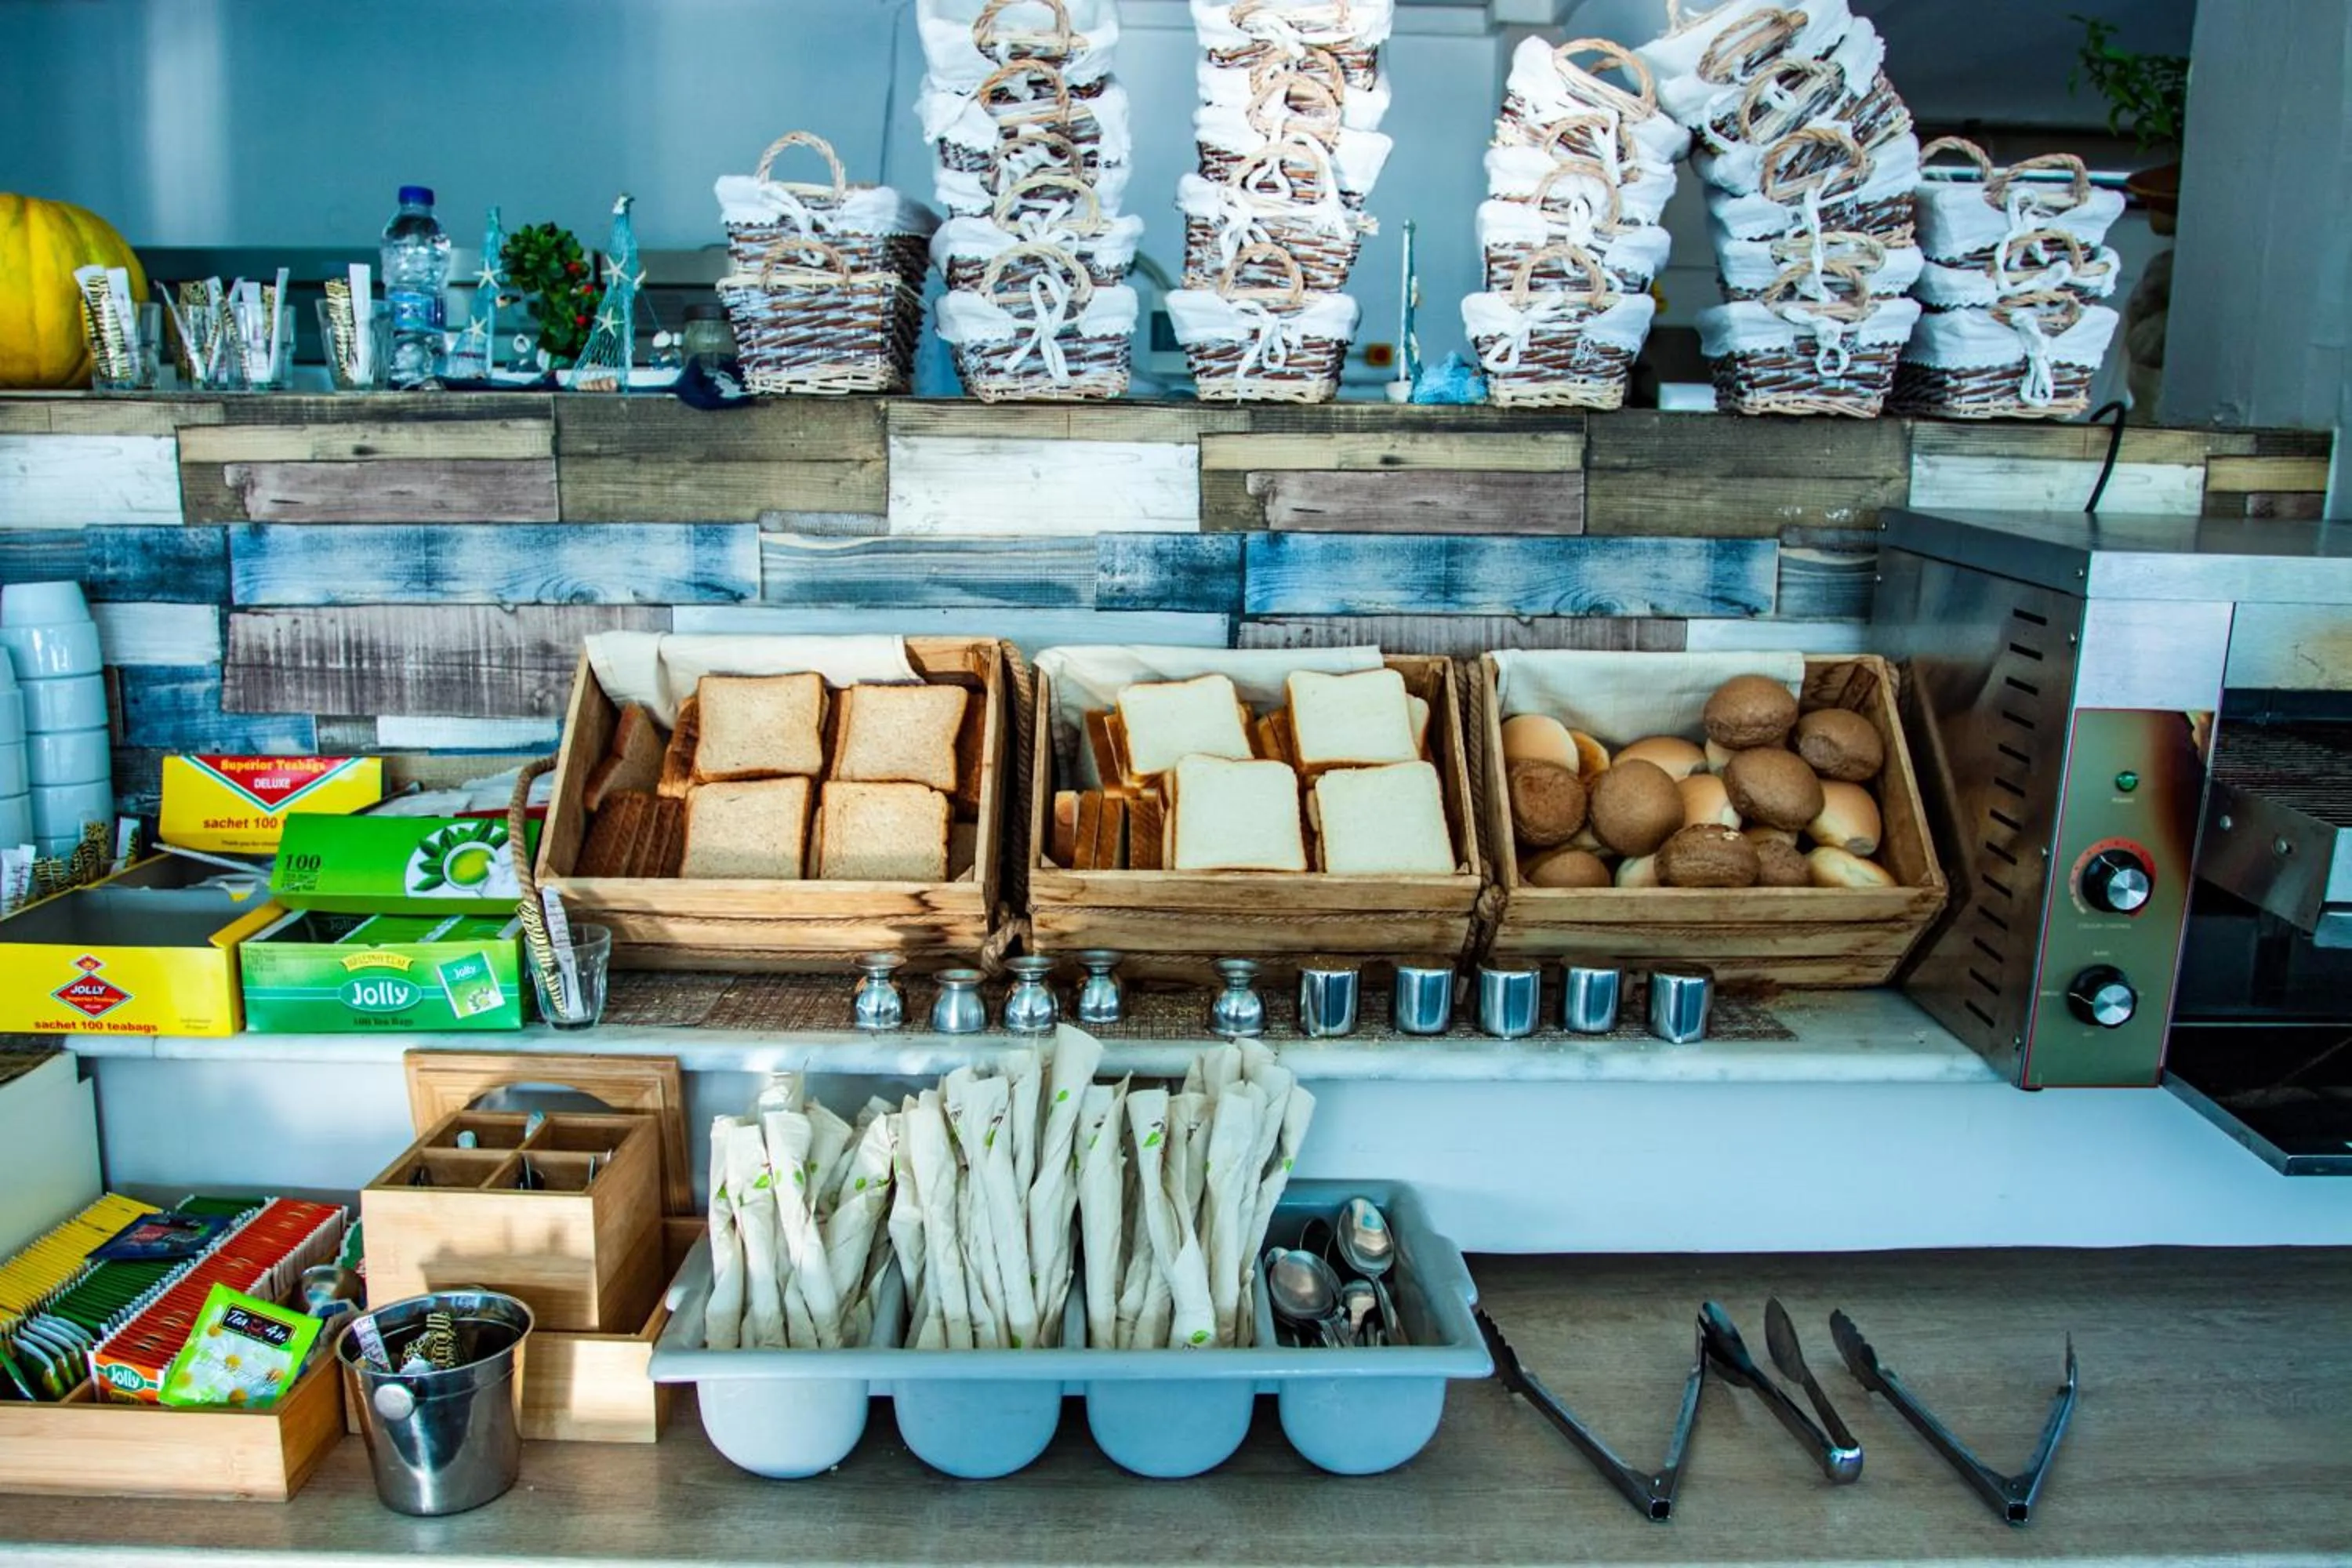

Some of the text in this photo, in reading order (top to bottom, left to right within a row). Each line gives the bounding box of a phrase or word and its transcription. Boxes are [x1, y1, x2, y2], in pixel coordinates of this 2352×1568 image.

[220, 759, 326, 774] Superior Teabags
[253, 778, 291, 789] DELUXE
[203, 817, 249, 829] sachet
[255, 818, 278, 829] 100
[285, 853, 321, 870] 100
[71, 985, 107, 995] JOLLY
[352, 982, 408, 1006] Jolly
[34, 1020, 158, 1033] sachet 100 teabags
[110, 1365, 140, 1388] Jolly
